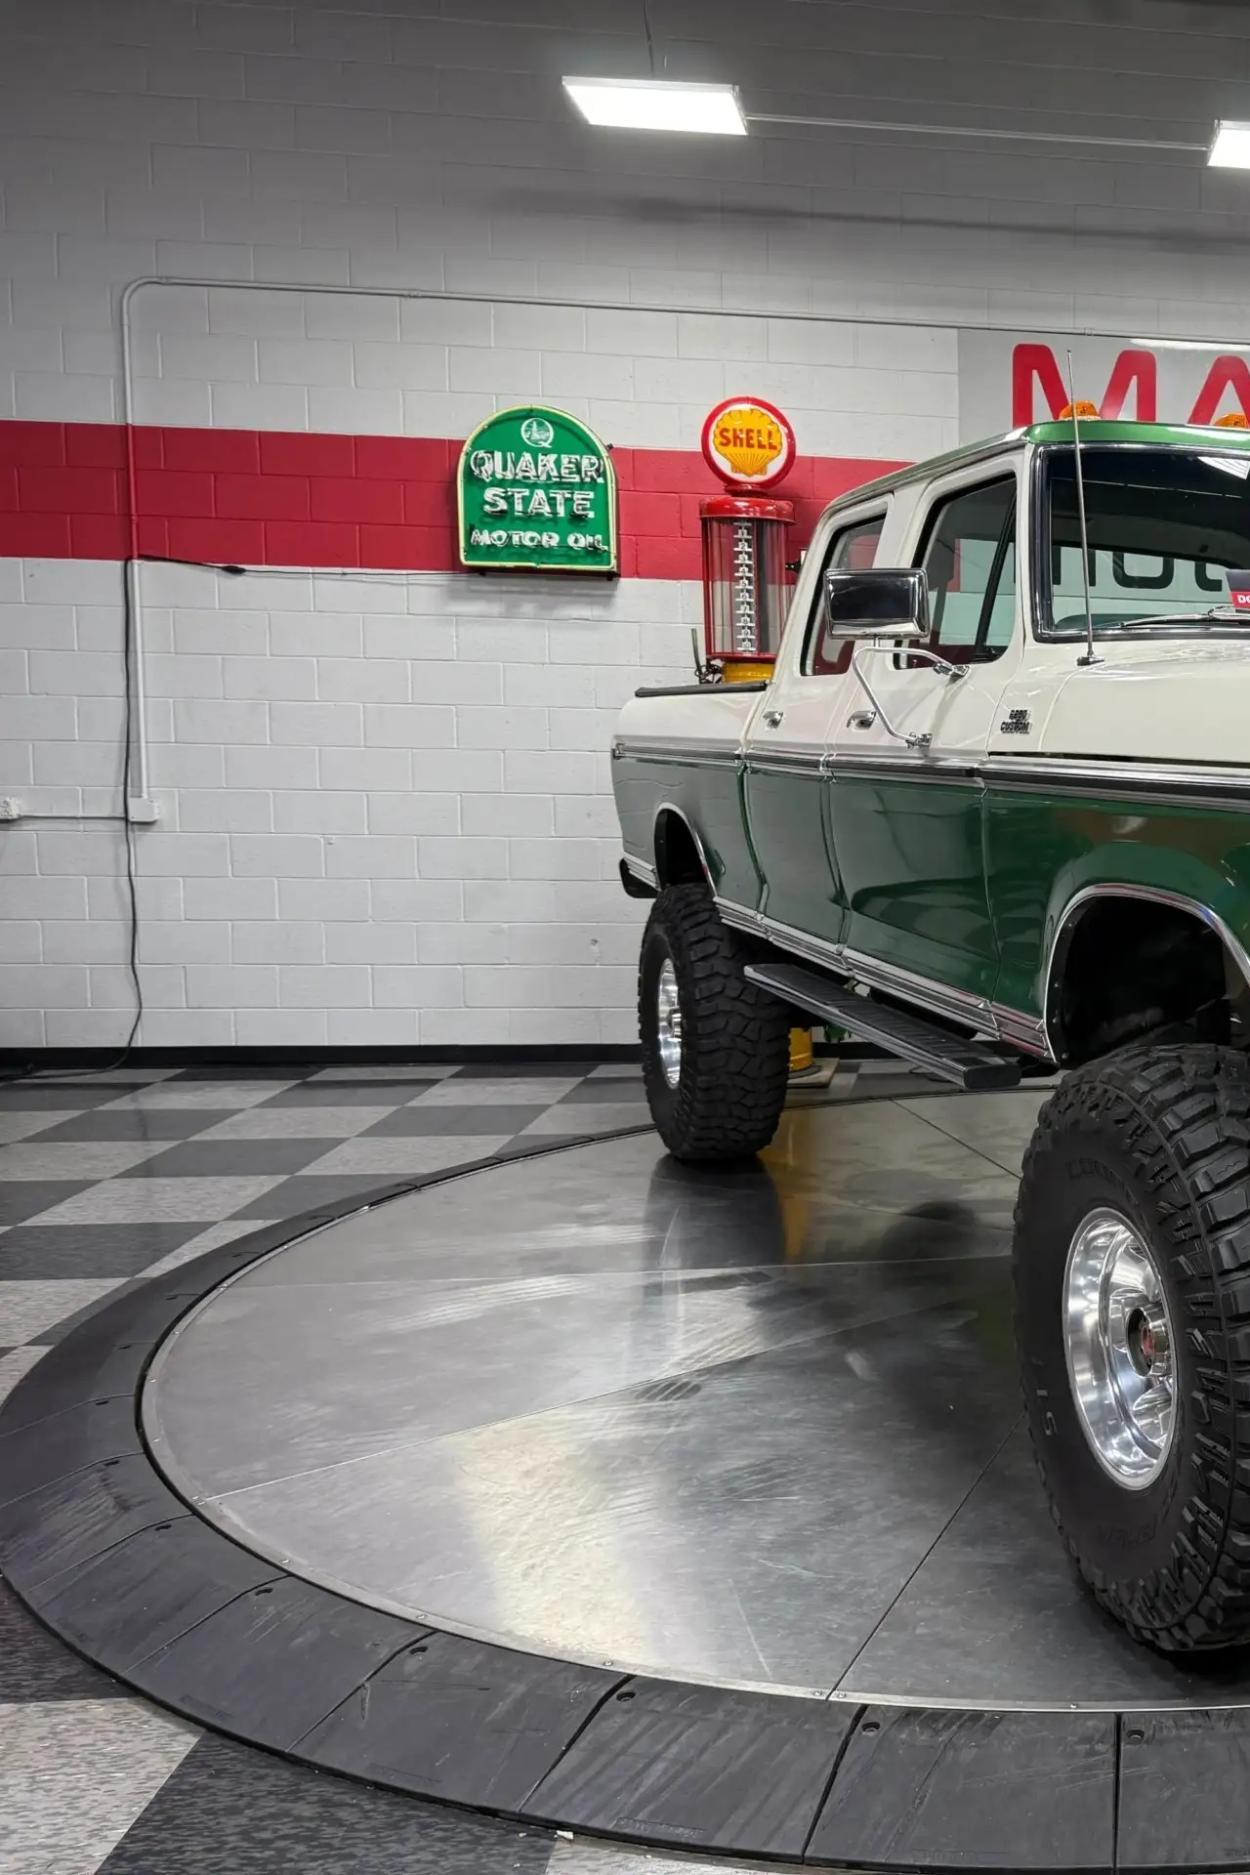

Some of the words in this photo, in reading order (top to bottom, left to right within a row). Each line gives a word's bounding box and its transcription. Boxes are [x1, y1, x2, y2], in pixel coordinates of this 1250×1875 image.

[719, 427, 778, 450] SHELL
[470, 449, 605, 483] QUAKER
[483, 487, 595, 518] STATE
[470, 529, 560, 548] MOTOR
[567, 532, 608, 551] OIL
